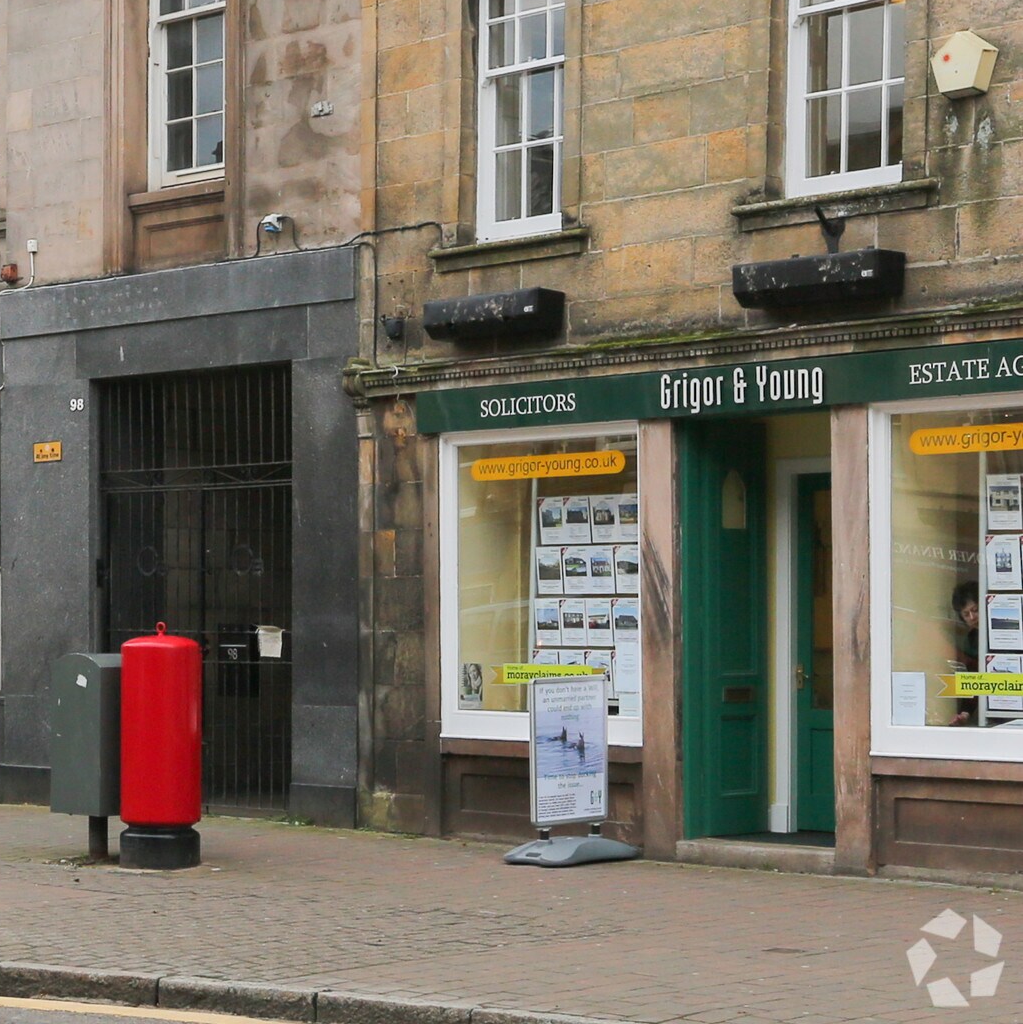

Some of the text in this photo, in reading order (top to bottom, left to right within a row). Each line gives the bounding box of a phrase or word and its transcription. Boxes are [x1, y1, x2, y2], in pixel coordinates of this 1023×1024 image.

[909, 358, 990, 384] ESTATE
[660, 365, 823, 414] Grigor & Young
[69, 398, 84, 411] 98
[480, 392, 576, 418] SOLICITORS
[920, 428, 1023, 449] www.grigor-y
[479, 454, 617, 477] www.grigor-young.co.uk
